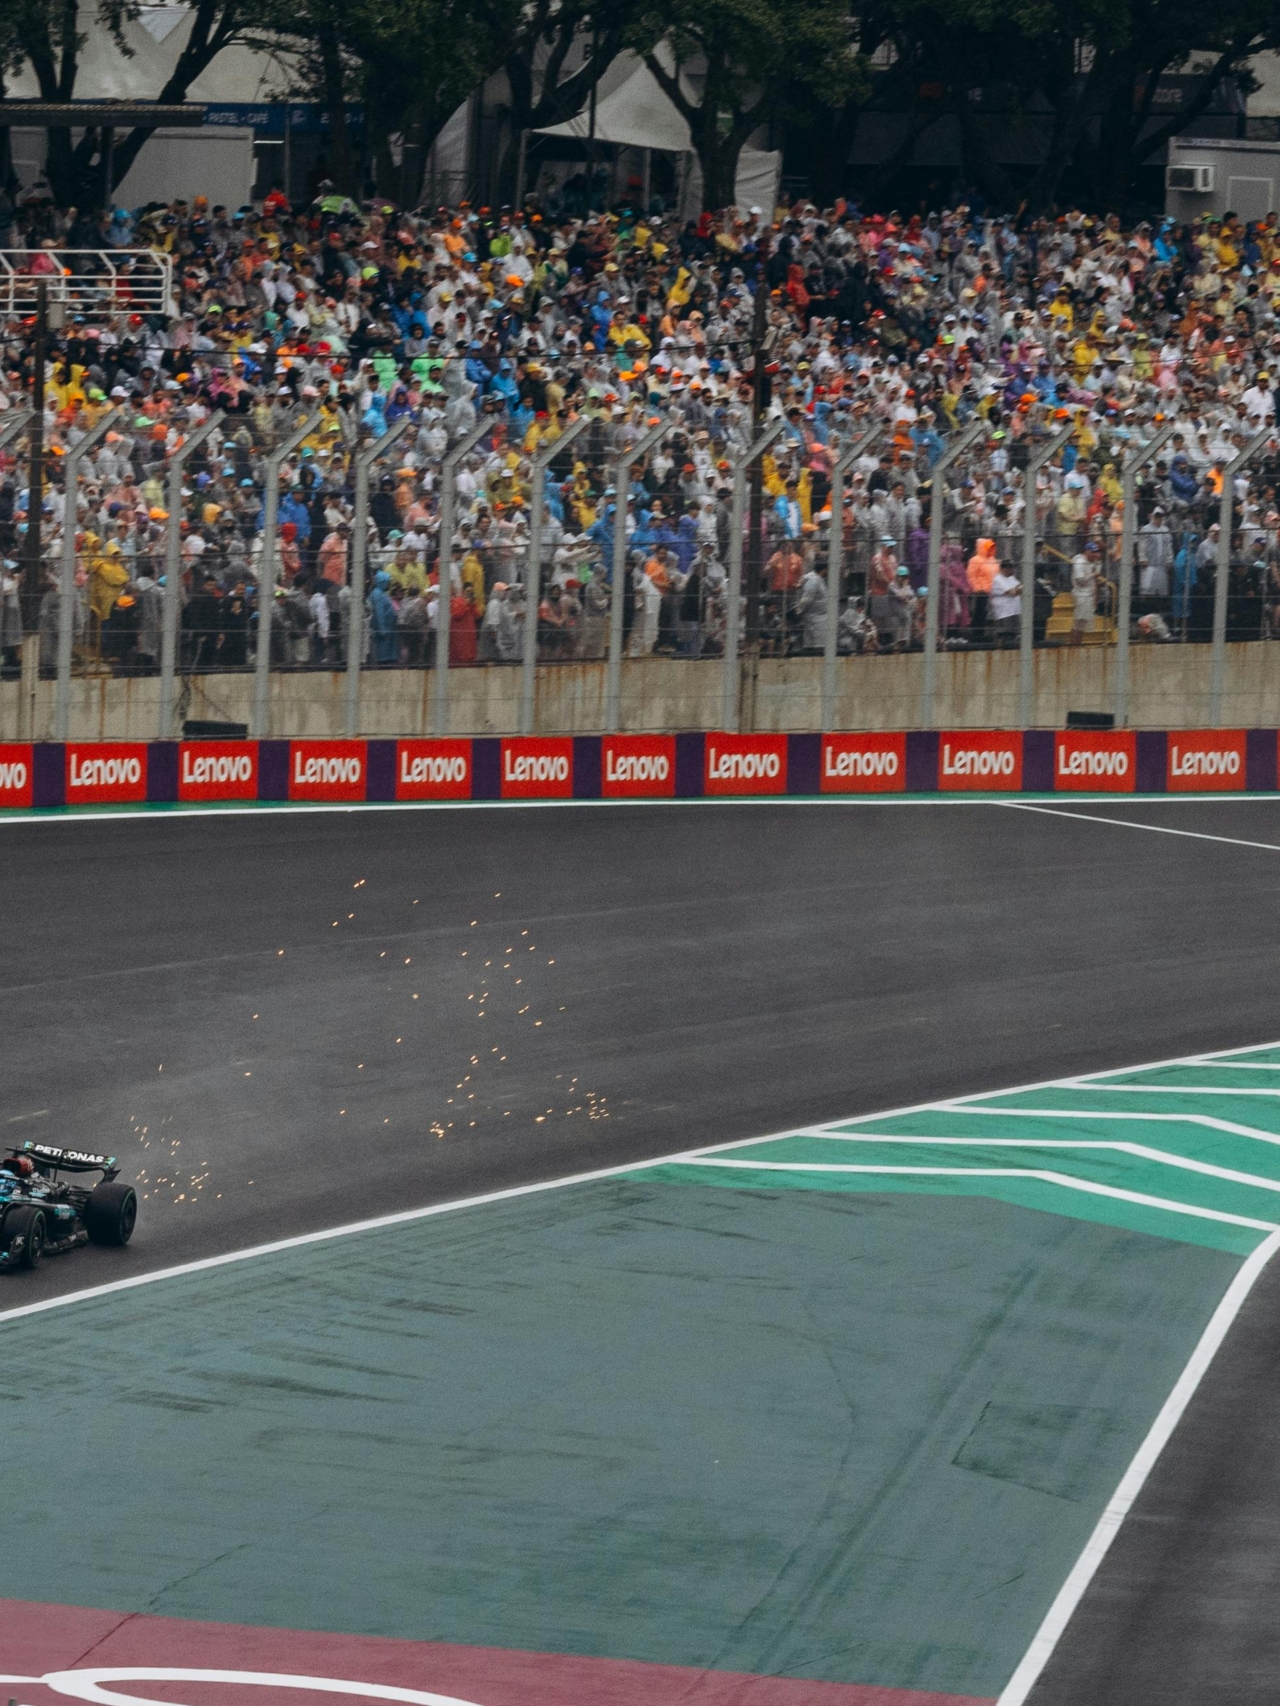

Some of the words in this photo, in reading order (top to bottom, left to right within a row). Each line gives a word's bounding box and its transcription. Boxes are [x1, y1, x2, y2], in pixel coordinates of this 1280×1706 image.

[70, 753, 141, 787] Lenovo
[182, 751, 252, 784] Lenovo
[294, 751, 361, 784] Lenovo
[401, 751, 466, 783] Lenovo
[505, 749, 569, 781] Lenovo
[606, 750, 669, 782] Lenovo
[708, 747, 780, 779] Lenovo
[825, 746, 899, 777] Lenovo
[942, 744, 1015, 776] Lenovo
[1058, 744, 1129, 776] Lenovo
[1171, 746, 1241, 776] Lenovo
